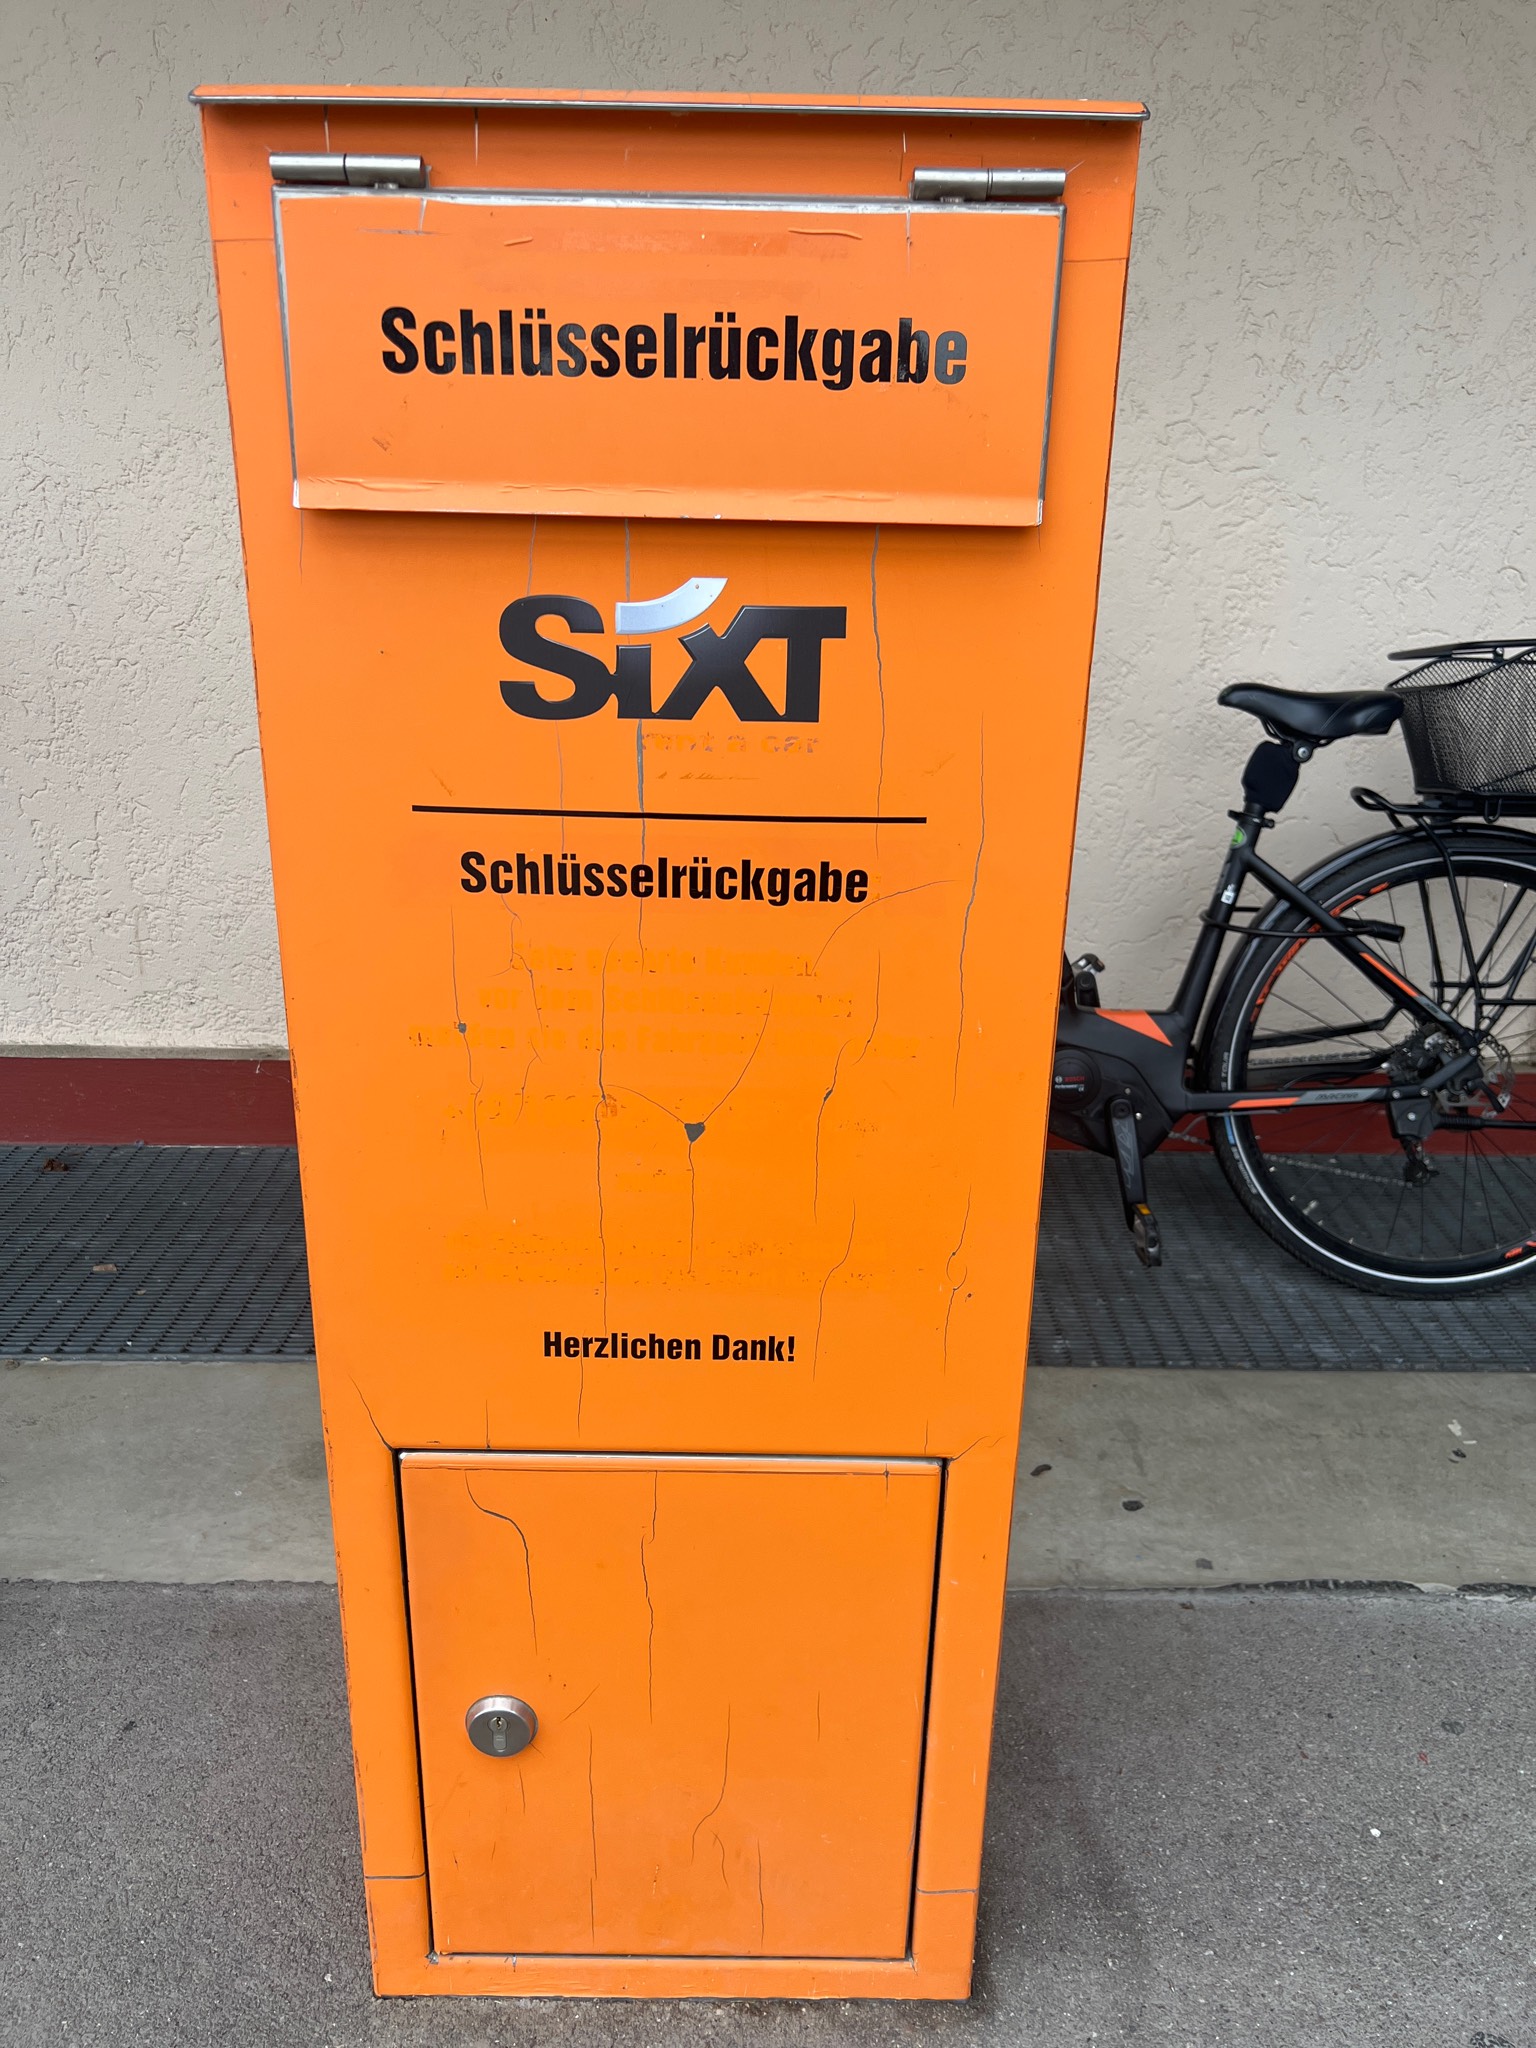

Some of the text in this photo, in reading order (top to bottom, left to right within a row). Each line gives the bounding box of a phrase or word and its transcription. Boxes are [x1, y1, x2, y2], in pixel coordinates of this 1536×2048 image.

[381, 306, 968, 391] Schlüsselrückgabe
[460, 851, 869, 907] Schlüsselrückgabe
[543, 1331, 795, 1363] Herzlichen Dank!
